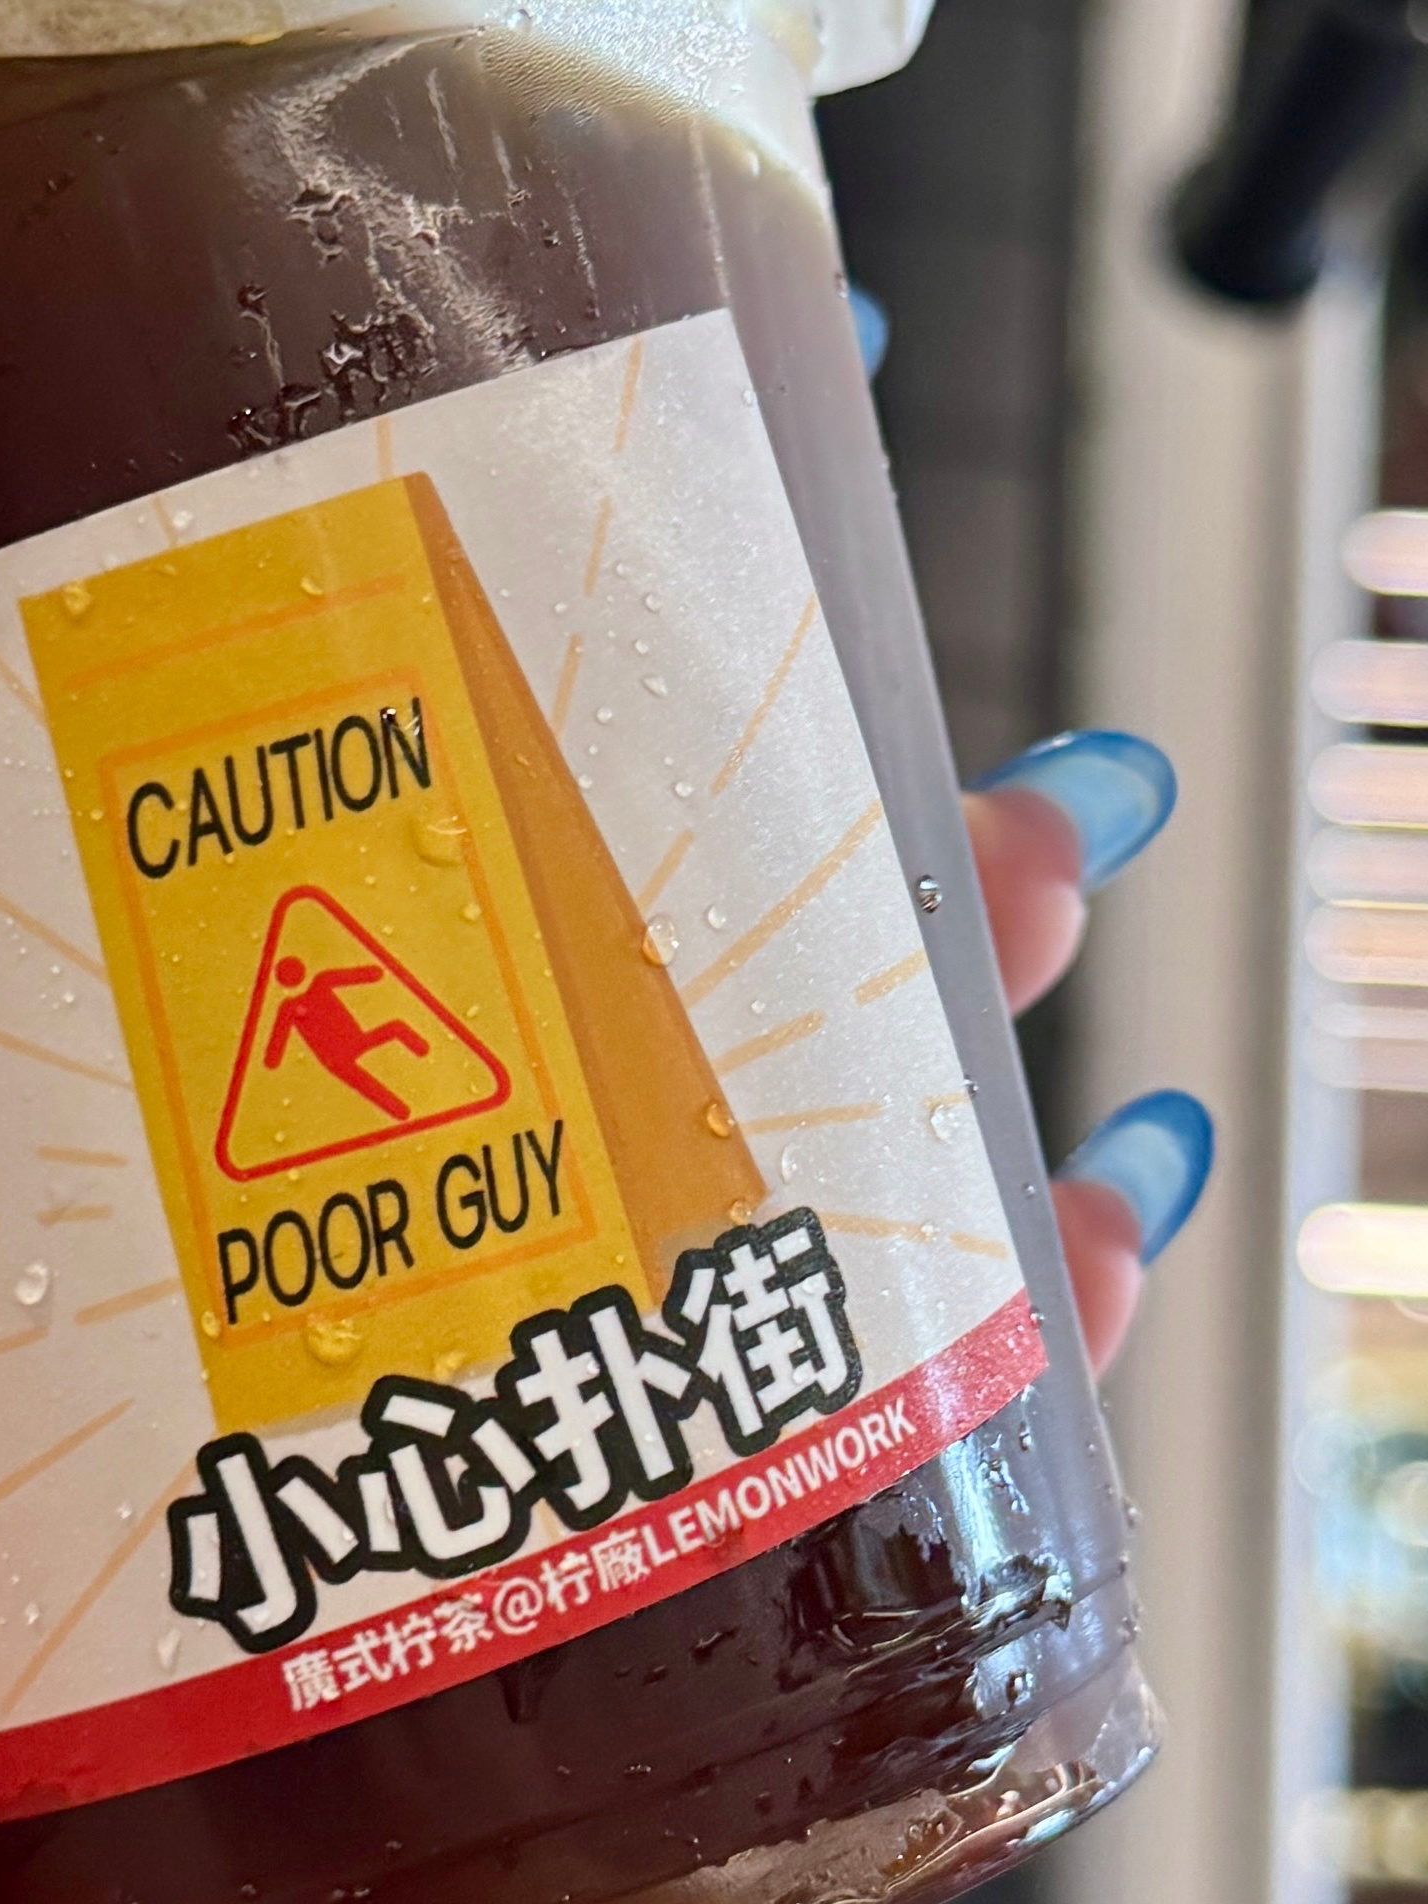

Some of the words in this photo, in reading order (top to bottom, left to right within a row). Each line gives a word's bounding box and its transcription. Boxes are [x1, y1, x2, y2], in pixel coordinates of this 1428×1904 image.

[126, 697, 432, 879] CAUTION
[217, 1179, 415, 1324] POOR
[435, 1119, 564, 1249] GUY
[172, 1211, 859, 1649] 小心扑街
